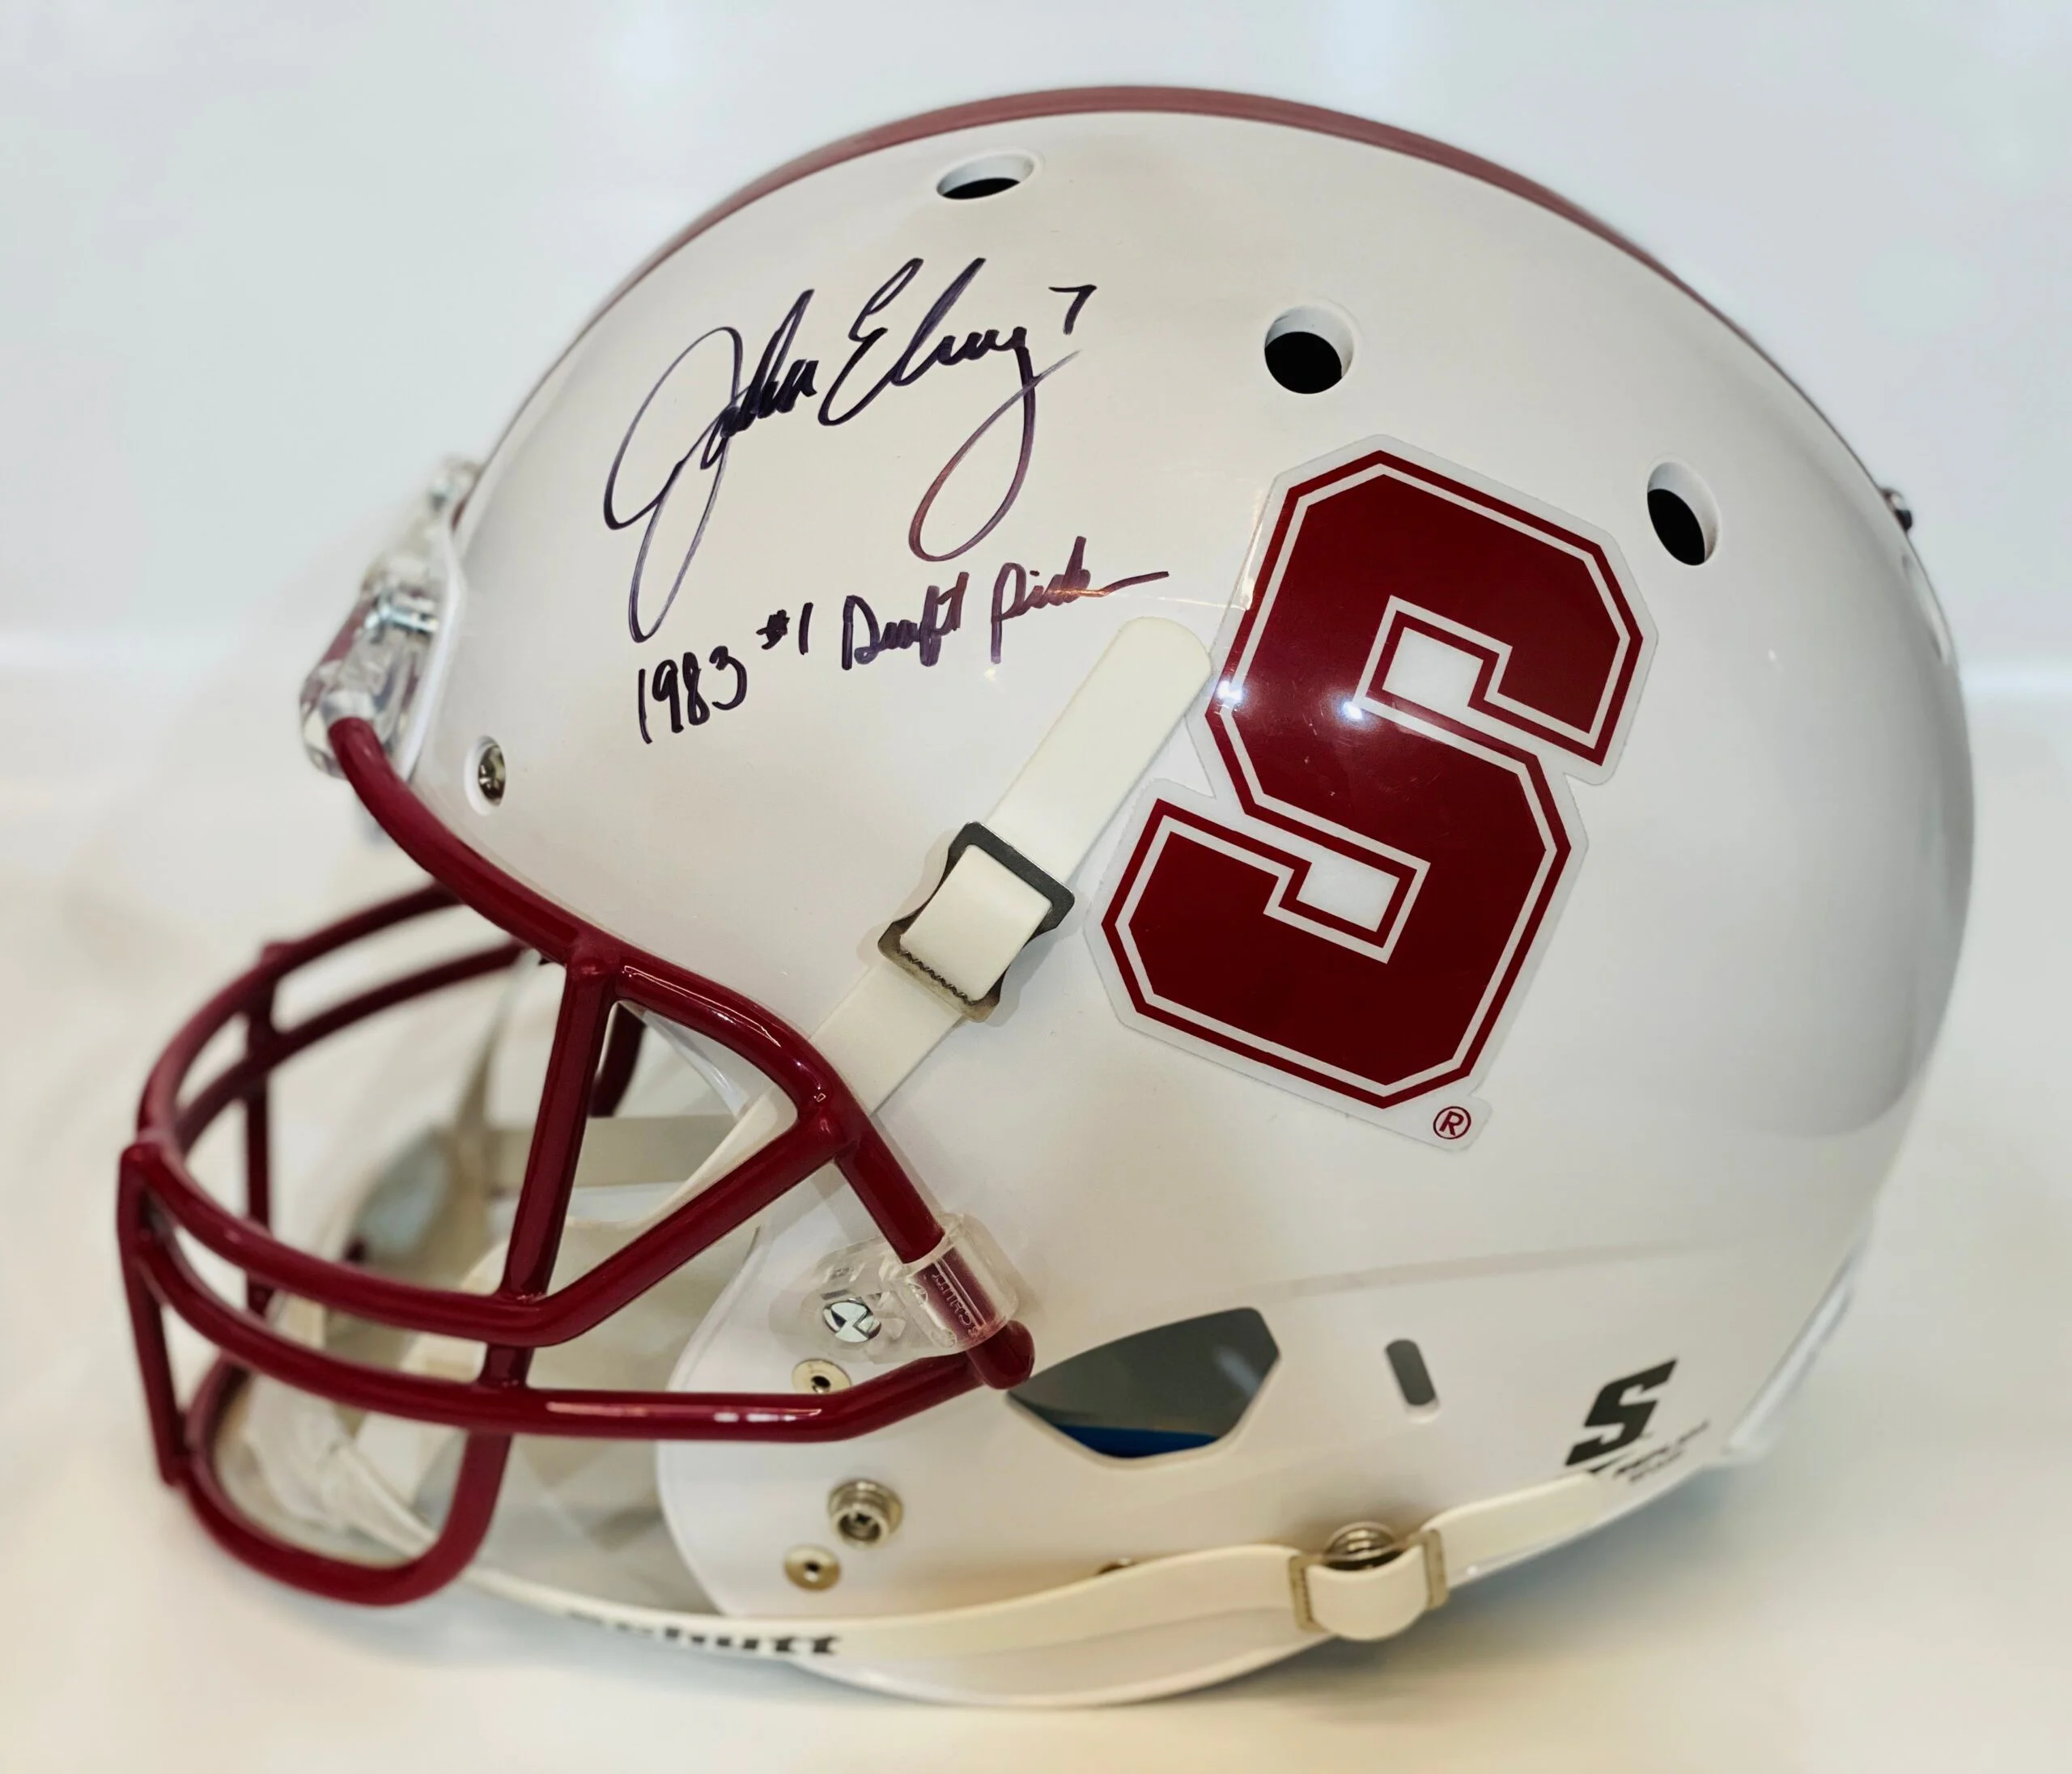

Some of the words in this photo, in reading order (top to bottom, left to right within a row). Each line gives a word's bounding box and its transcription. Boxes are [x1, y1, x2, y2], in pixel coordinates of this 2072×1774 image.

[1048, 284, 1098, 335] 7
[637, 645, 748, 745] 1983
[755, 601, 814, 656] #1
[842, 571, 970, 671] Draft
[1100, 450, 1644, 1109] S
